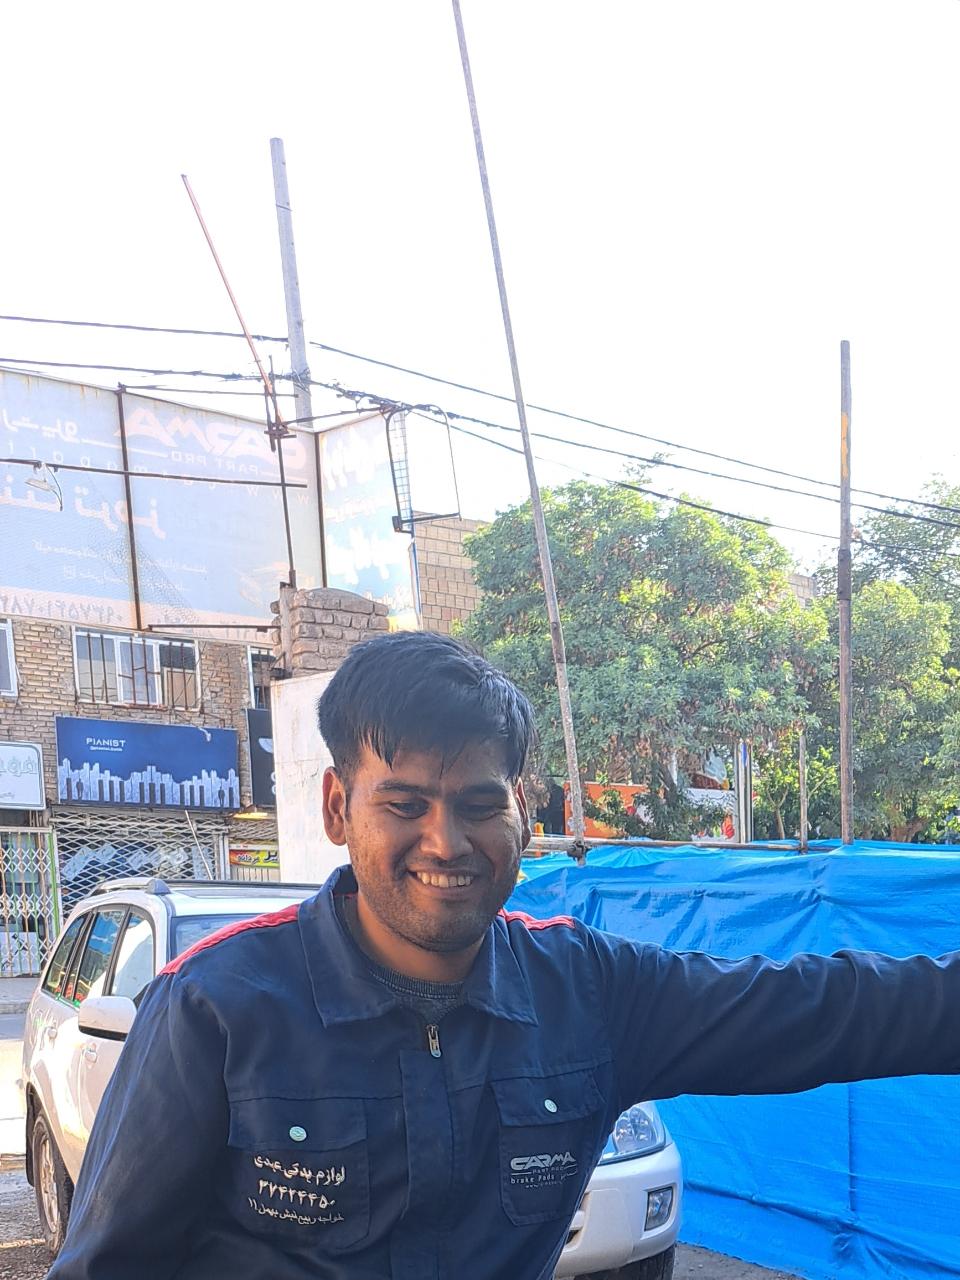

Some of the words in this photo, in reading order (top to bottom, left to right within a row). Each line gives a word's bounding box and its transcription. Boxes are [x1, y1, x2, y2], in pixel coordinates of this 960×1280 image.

[86, 737, 126, 747] PIANIST
[253, 1155, 284, 1173] عبدی
[510, 1151, 577, 1171] CARMA
[283, 1162, 314, 1183] یدکی
[315, 1163, 346, 1187] لوازم
